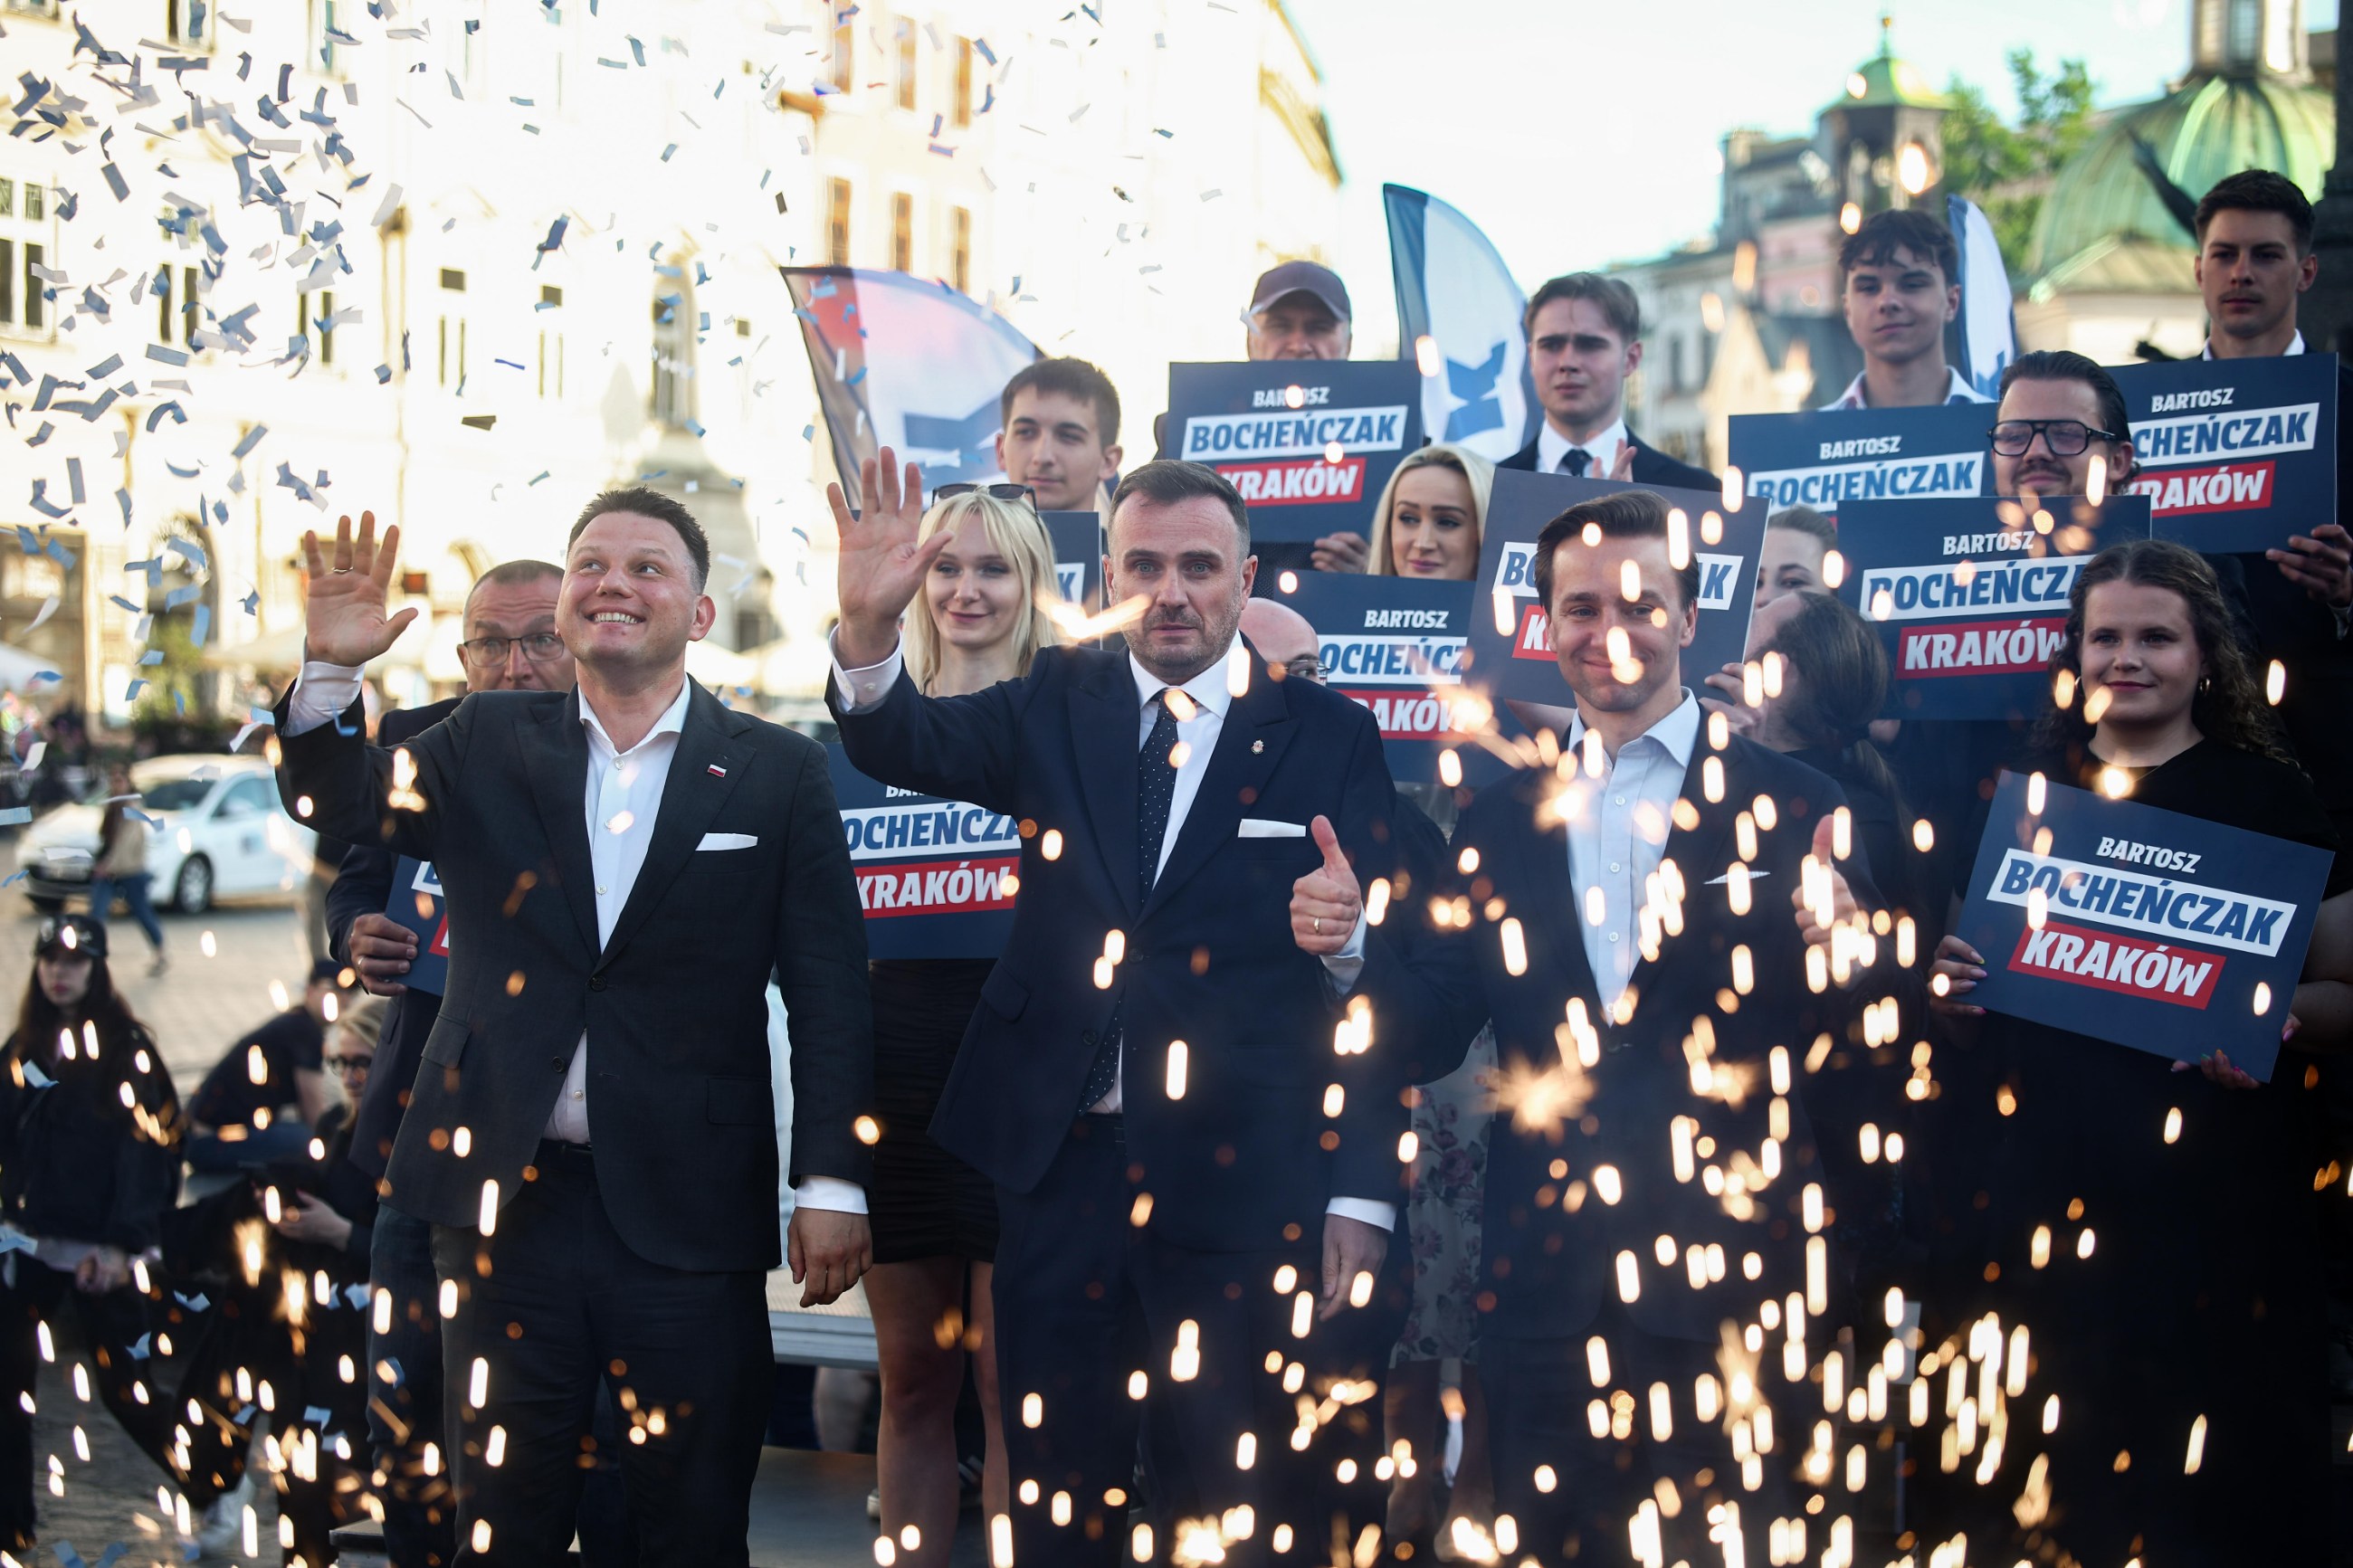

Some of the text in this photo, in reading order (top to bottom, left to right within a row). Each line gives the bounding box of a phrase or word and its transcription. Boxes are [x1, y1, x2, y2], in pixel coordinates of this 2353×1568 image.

[1253, 386, 1330, 408] BARSZ
[2151, 387, 2234, 413] BARTOSZ
[1190, 413, 1398, 452] BOCHEŃCZAK
[1820, 435, 1901, 460] BARTOSZ
[2131, 412, 2310, 459] CHEŃCZAK
[2127, 466, 2267, 510] RAKÓW
[1943, 530, 2035, 556] BARTOSZ
[1869, 561, 2085, 612] BOCHEŃCZ
[1364, 610, 1449, 629] BARTOSZ
[1319, 638, 1464, 676] OCHEŃCZ
[1351, 692, 1464, 732] AKÓ
[843, 803, 1019, 851] OCHEŃCZ
[2096, 836, 2201, 874] BARTOSZ
[856, 861, 1012, 909] KRAKÓW
[2000, 859, 2284, 946] BOCHEŃCZAK
[2021, 930, 2214, 997] KRAKÓW
